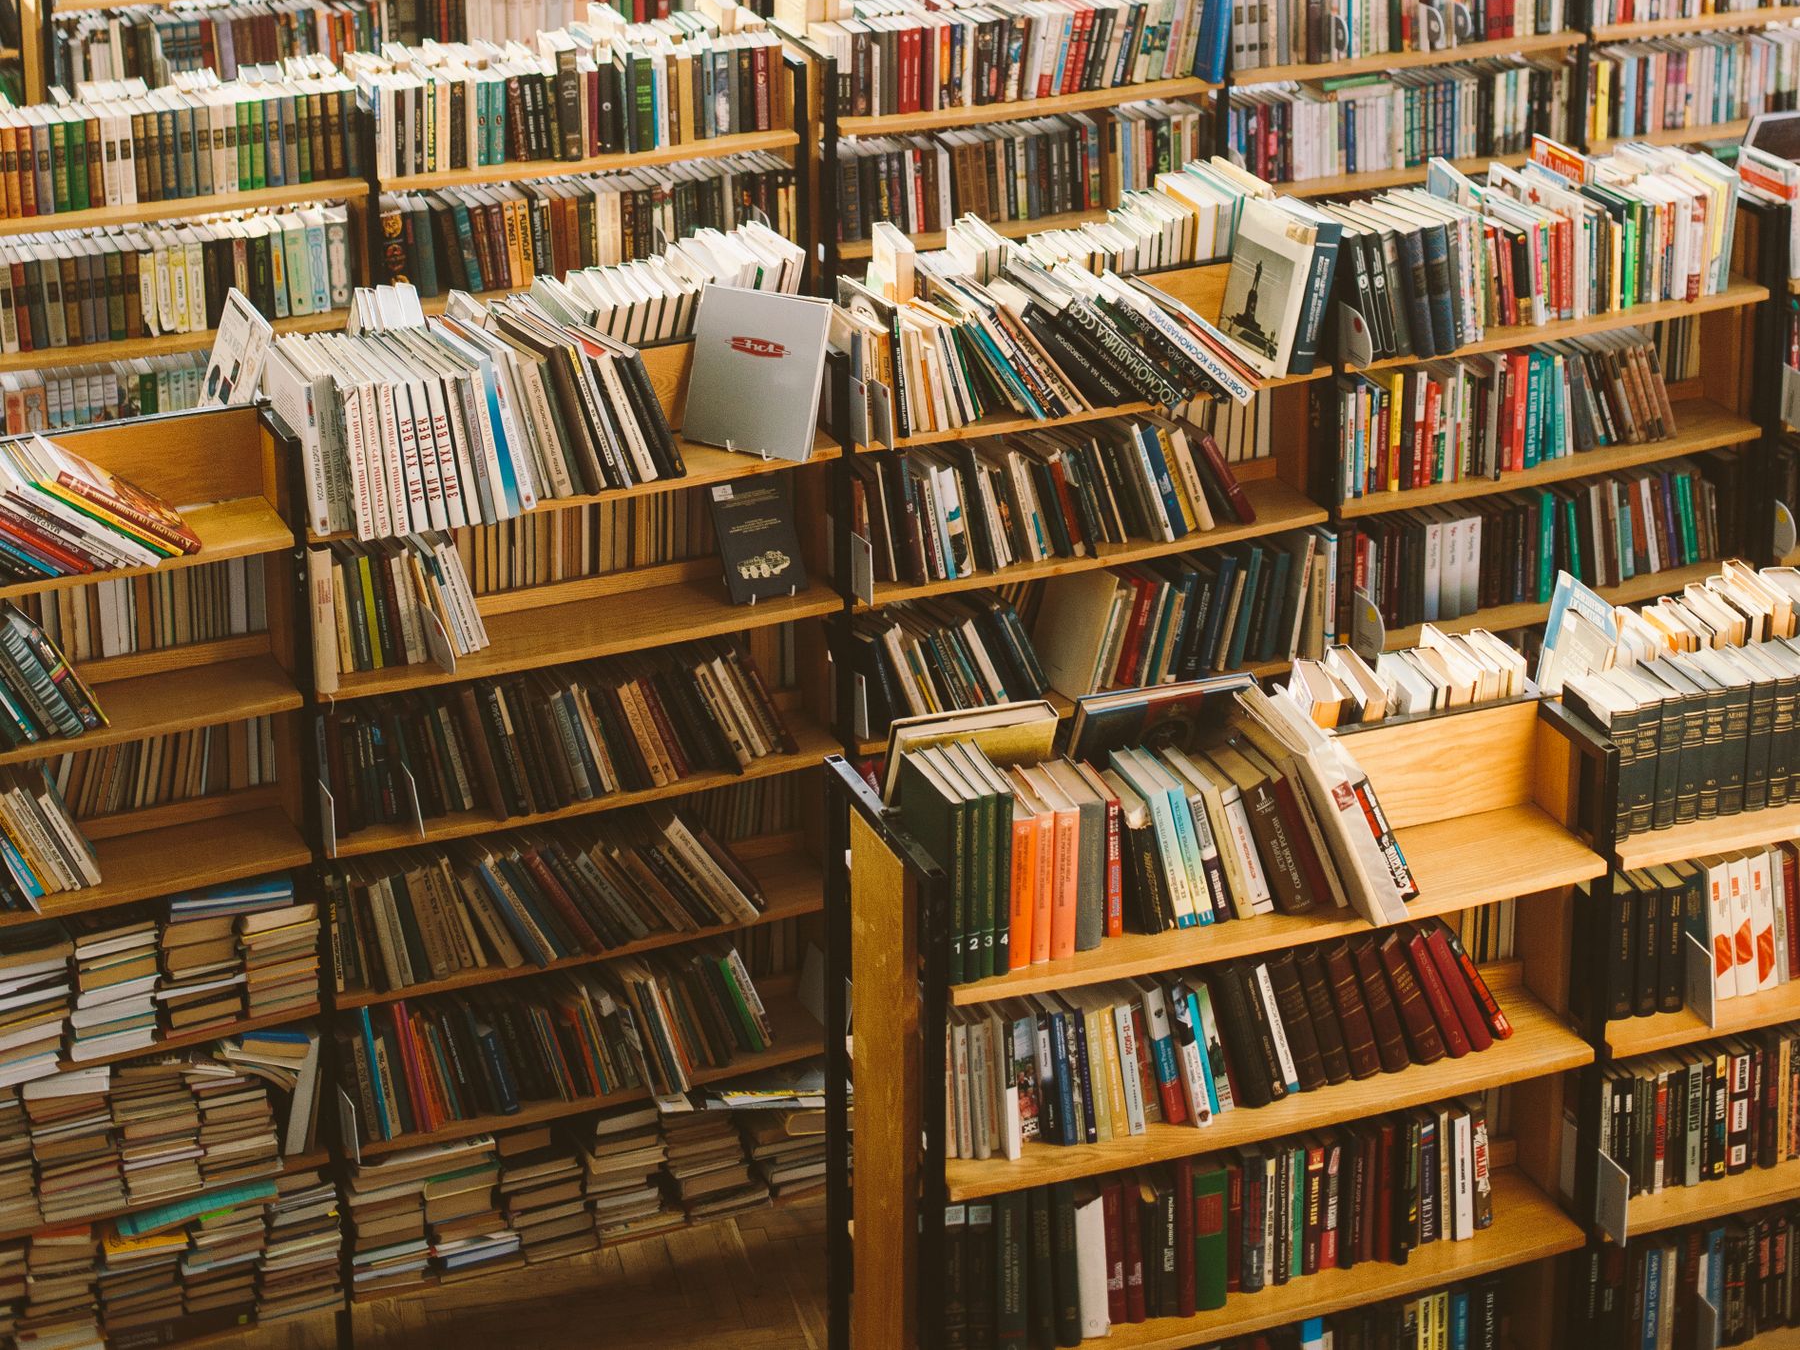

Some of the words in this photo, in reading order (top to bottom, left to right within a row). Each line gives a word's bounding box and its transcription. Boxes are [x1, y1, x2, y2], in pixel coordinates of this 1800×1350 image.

[507, 216, 515, 246] ГЕРАКЛ
[520, 213, 530, 260] АРГОНАВТЫ
[1145, 306, 1208, 365] КОСМОНАВТИКА
[1088, 365, 1099, 377] НА
[1091, 323, 1180, 408] КОСМОНАВТИКА
[1097, 374, 1121, 397] ДОРОГА
[1205, 361, 1247, 400] СОВЕТСКАЯ
[402, 417, 413, 440] ВЕК
[418, 416, 430, 439] ВЕК
[436, 414, 448, 437] ВЕК
[354, 420, 364, 466] ТРУДОВОЙ
[410, 477, 421, 502] ЗИЛ
[428, 476, 439, 501] ЗИЛ
[446, 474, 456, 498] ЗИЛ
[24, 509, 61, 535] МАКРАМЕ
[925, 486, 937, 531] ГАГАРИНА
[1154, 805, 1166, 839] ОТЕЧЕСТВА
[1173, 800, 1185, 834] ОТЕЧЕСТВА
[1271, 815, 1288, 846] РОССИИ
[1162, 839, 1173, 866] ИСТОРИЯ
[1181, 834, 1192, 862] ИСТОРИЯ
[1282, 847, 1302, 888] СОВЕТСКОЙ
[954, 943, 962, 954] 1
[969, 938, 979, 950] 2
[984, 936, 994, 948] 3
[1000, 933, 1009, 946] 4
[1689, 1072, 1700, 1131] СТАЛИН-ТИТО
[1715, 1088, 1725, 1119] СТАЛИН
[1475, 1146, 1486, 1177] ПУТИН
[1649, 1254, 1659, 1299] СОВЕТНИКИ
[1646, 1309, 1656, 1337] ВОЖДИ
